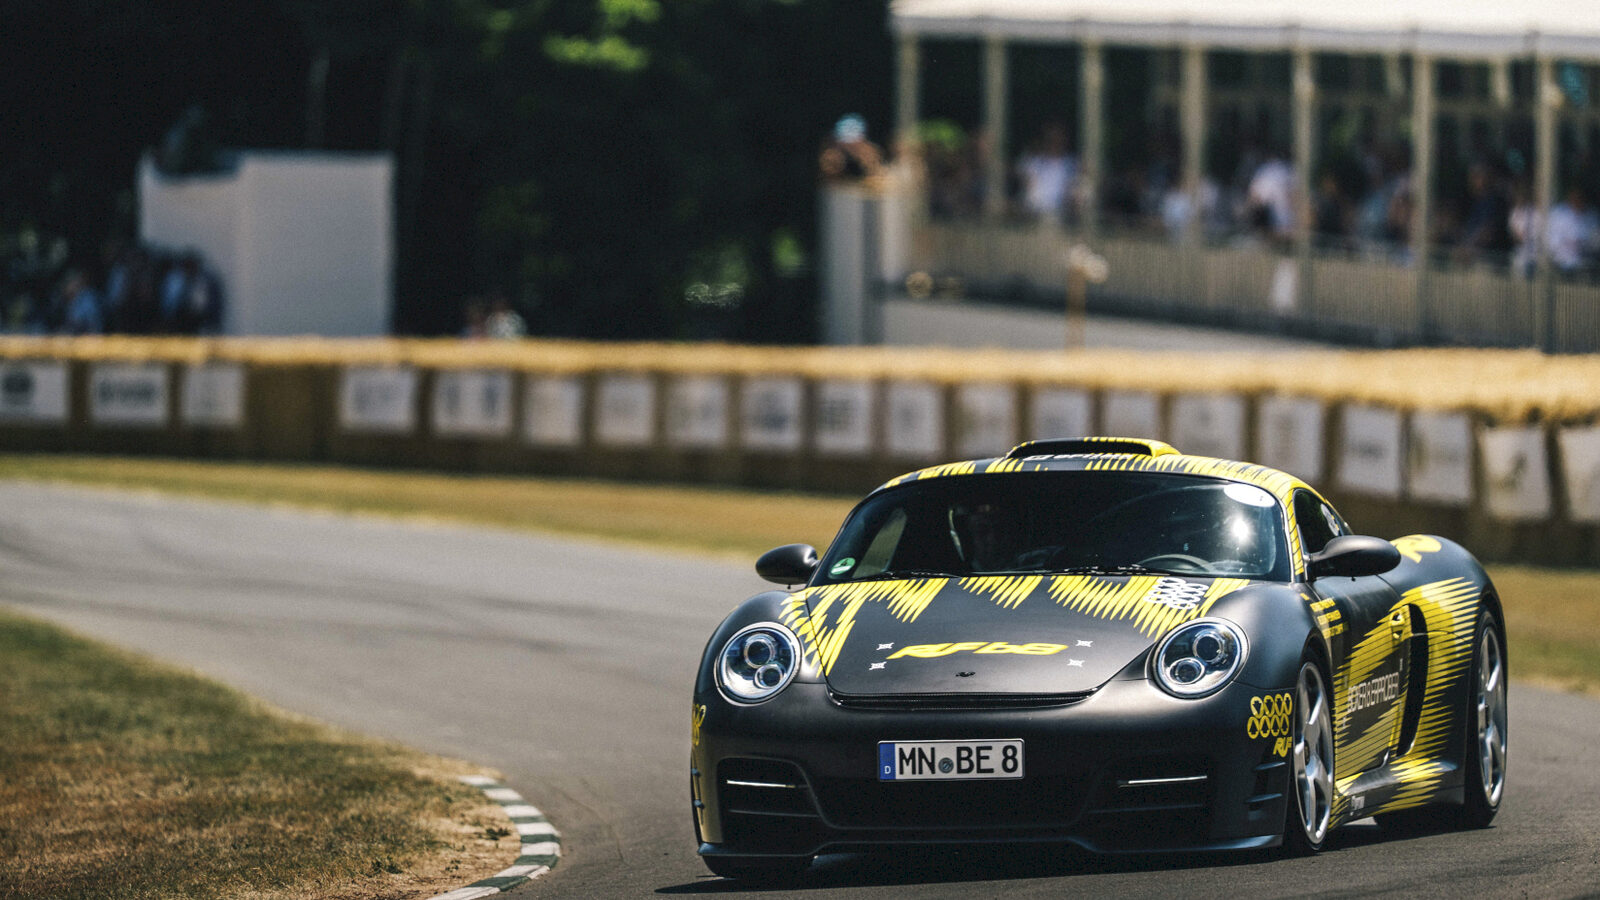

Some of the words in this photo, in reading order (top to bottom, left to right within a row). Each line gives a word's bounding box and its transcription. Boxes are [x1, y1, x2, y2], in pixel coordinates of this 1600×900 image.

[1273, 736, 1292, 757] RUF
[884, 766, 892, 775] D
[898, 747, 936, 775] MN
[956, 746, 994, 774] BE
[1001, 745, 1018, 774] 8
